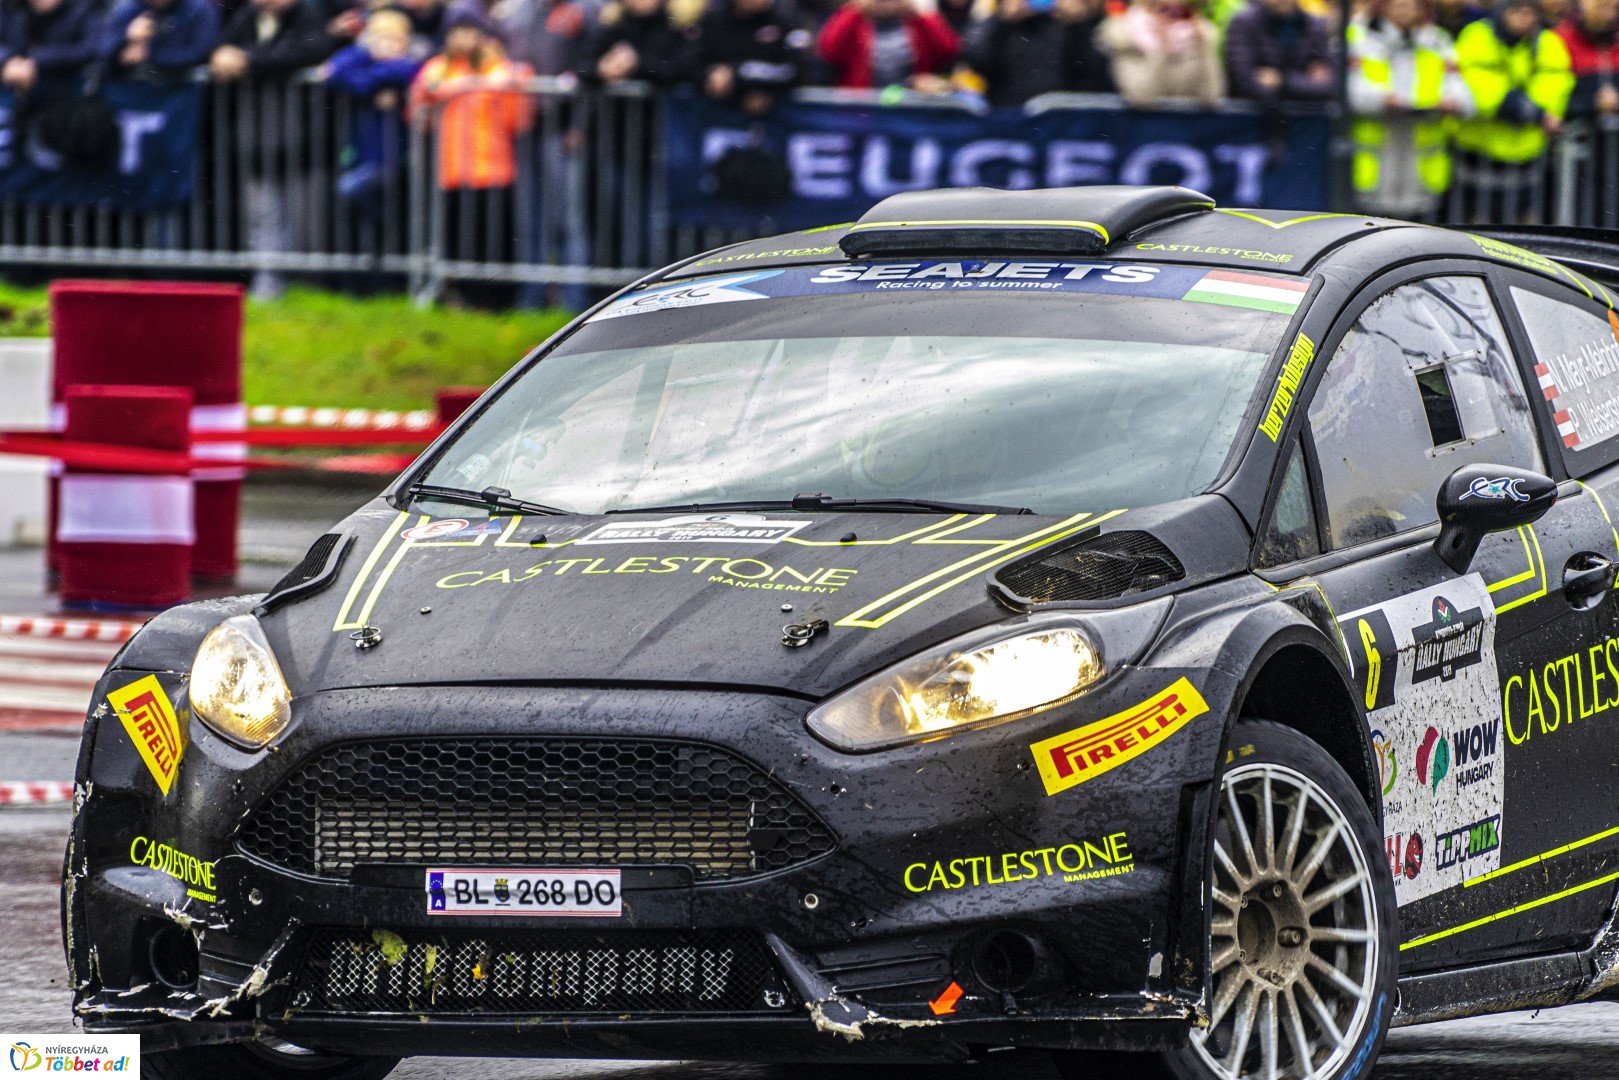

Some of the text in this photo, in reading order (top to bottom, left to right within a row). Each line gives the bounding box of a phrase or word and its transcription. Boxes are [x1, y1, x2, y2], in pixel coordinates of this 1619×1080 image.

[1136, 243, 1294, 262] CASTLESTONE
[811, 261, 1161, 283] SEAJETS
[876, 280, 1063, 291] Racing to summer
[599, 529, 785, 539] RALLY HUNGARY
[436, 556, 858, 589] CASTLESTONE
[707, 575, 839, 594] MANAGEMENT
[1415, 641, 1443, 672] RALLY
[1442, 620, 1483, 663] HUNGARY
[1358, 618, 1382, 710] 6
[1504, 637, 1619, 746] CASTLES
[124, 690, 178, 779] PIRELLI
[1050, 693, 1188, 779] PIRELLI
[1453, 717, 1499, 767] WOW
[1455, 761, 1494, 789] HUNGARY
[130, 836, 217, 891] CASTLESTONE
[904, 832, 1133, 893] CASTLESTONE
[1063, 863, 1135, 883] MANAGEMENT
[434, 899, 442, 908] A
[454, 878, 616, 906] BL 268 DO
